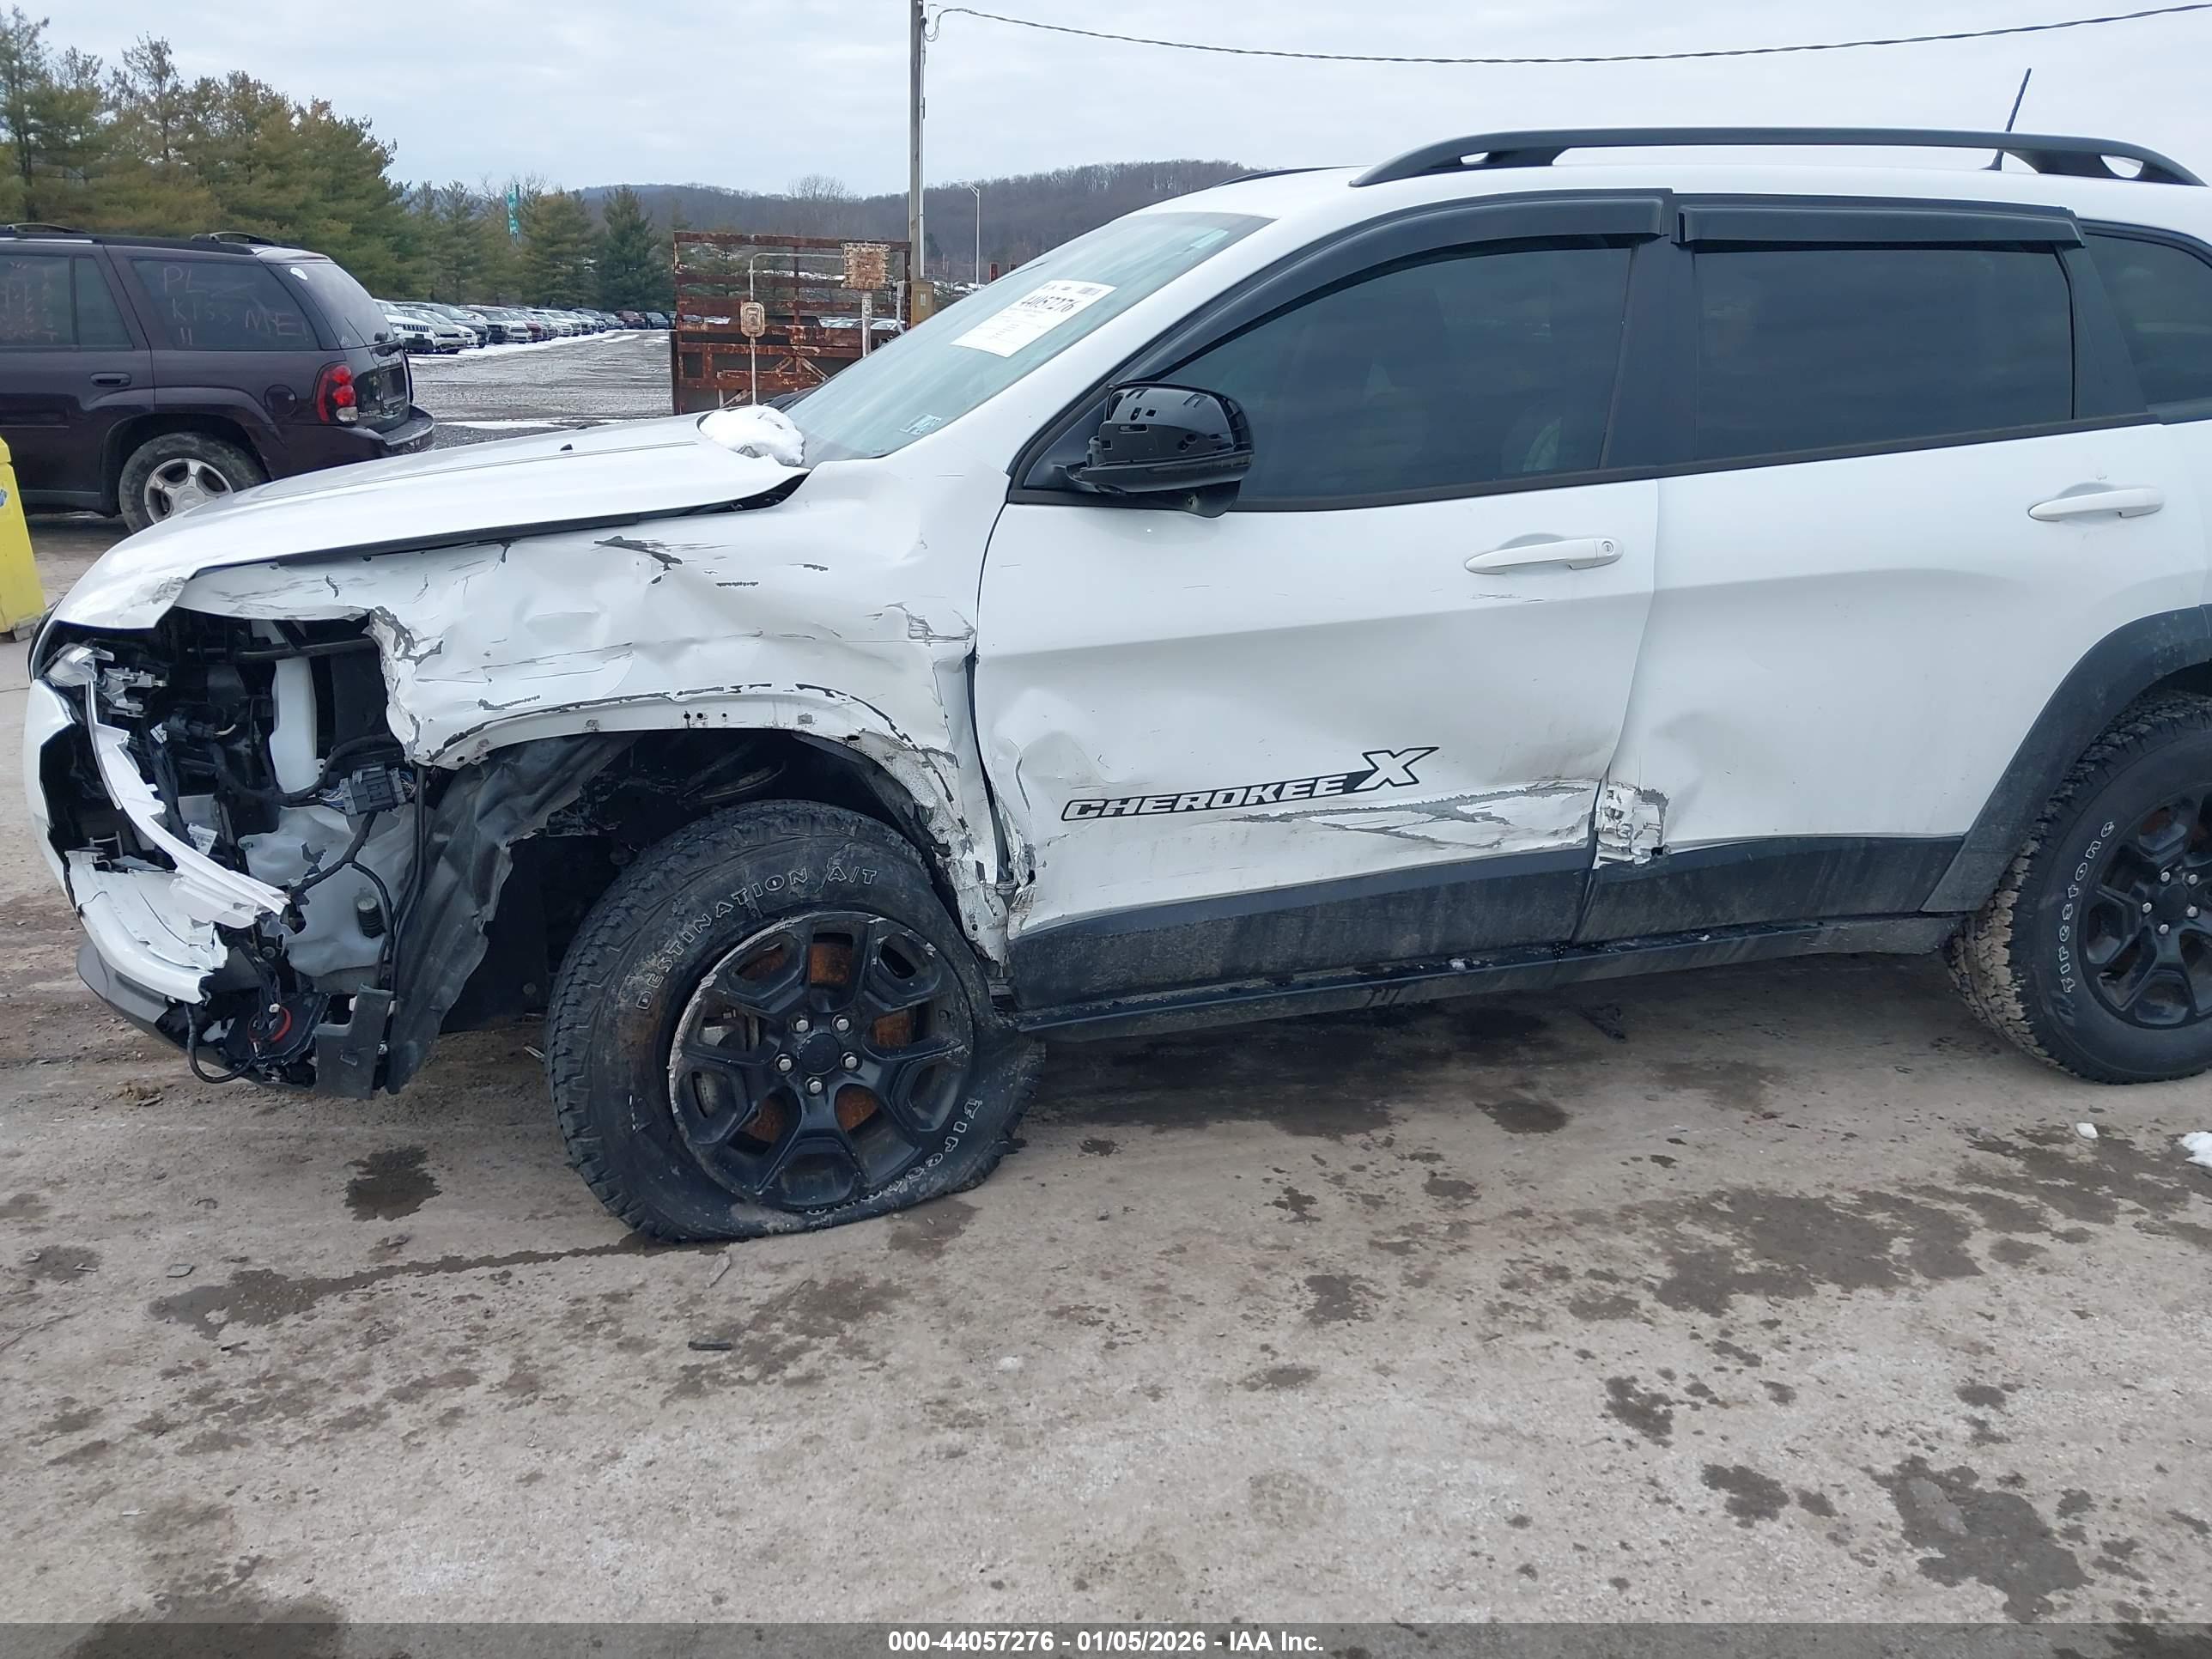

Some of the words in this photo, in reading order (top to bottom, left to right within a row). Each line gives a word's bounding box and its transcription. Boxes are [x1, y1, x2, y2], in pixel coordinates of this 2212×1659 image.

[1062, 774, 1349, 822] CHEROKEE
[1353, 746, 1440, 792] X
[635, 866, 810, 1011] DESTINATION
[827, 866, 878, 885] A/T
